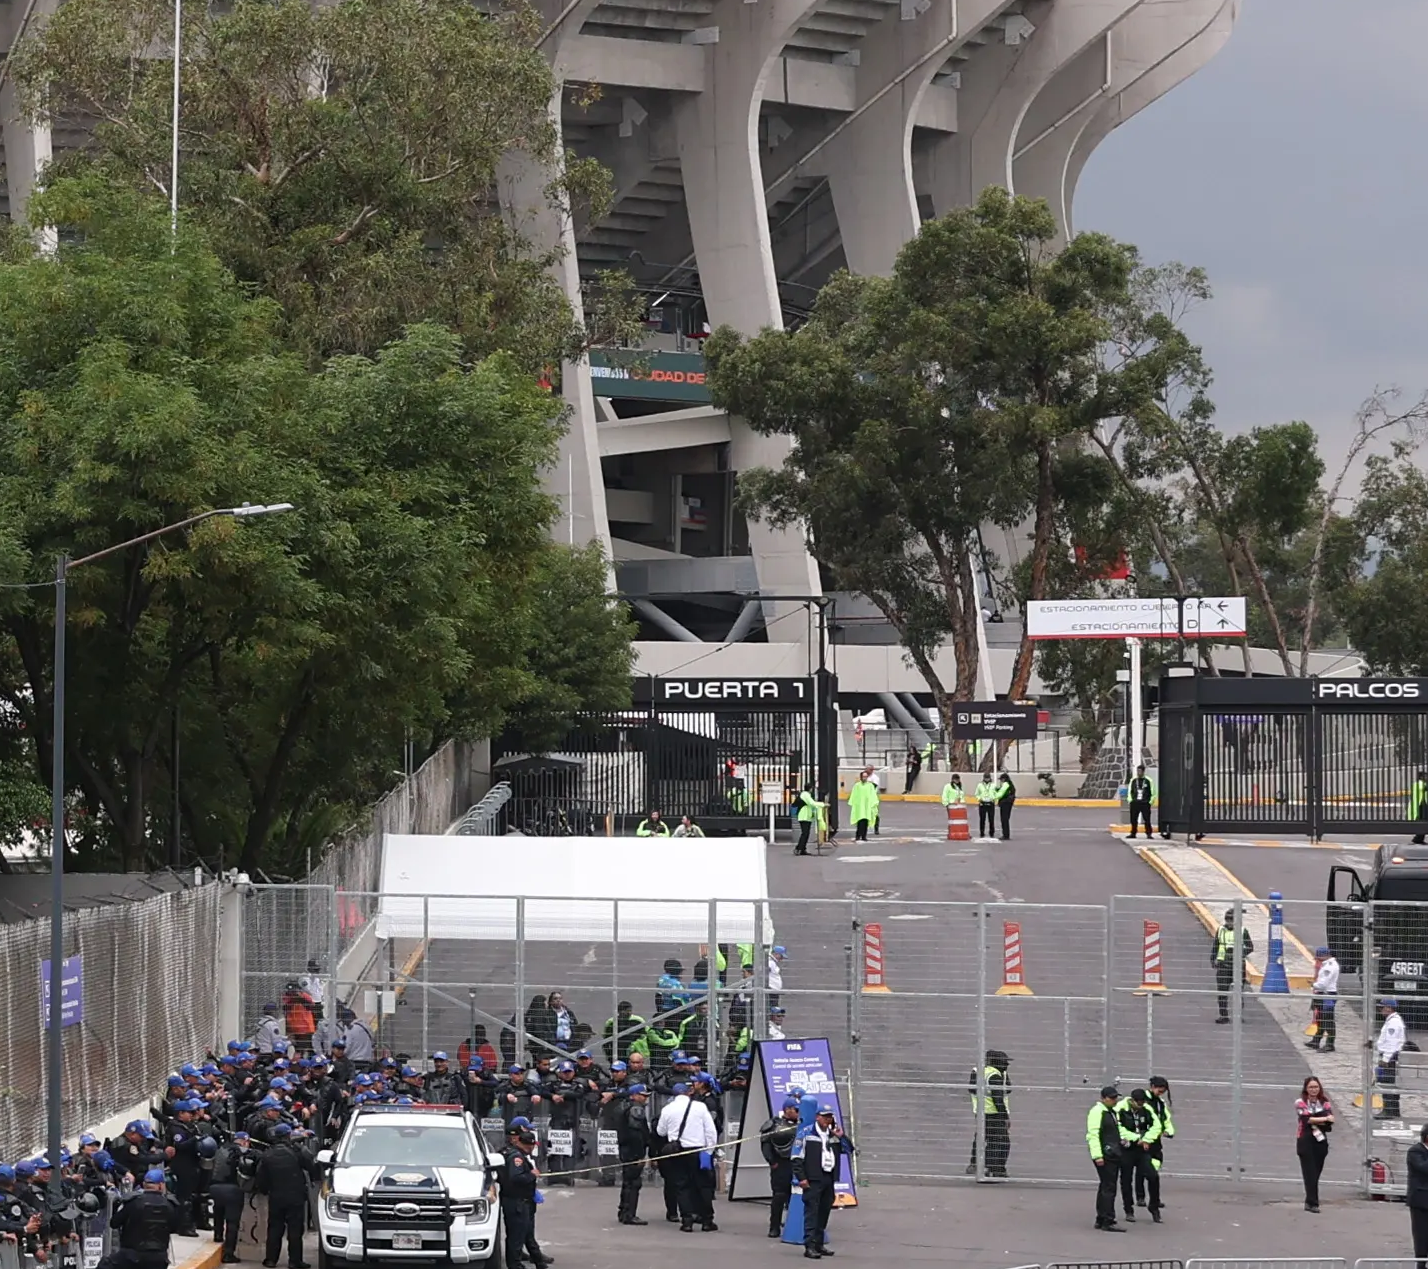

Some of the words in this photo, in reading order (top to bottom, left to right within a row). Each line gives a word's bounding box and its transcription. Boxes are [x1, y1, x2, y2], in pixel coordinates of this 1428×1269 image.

[686, 372, 706, 385] DE
[1039, 604, 1138, 613] ESTACIONAMIENTO
[1071, 622, 1180, 631] ESTACIONAMIENTO
[1186, 619, 1199, 629] D
[664, 681, 779, 699] PUERTA
[793, 682, 805, 698] 1
[1318, 683, 1420, 698] PALCOS
